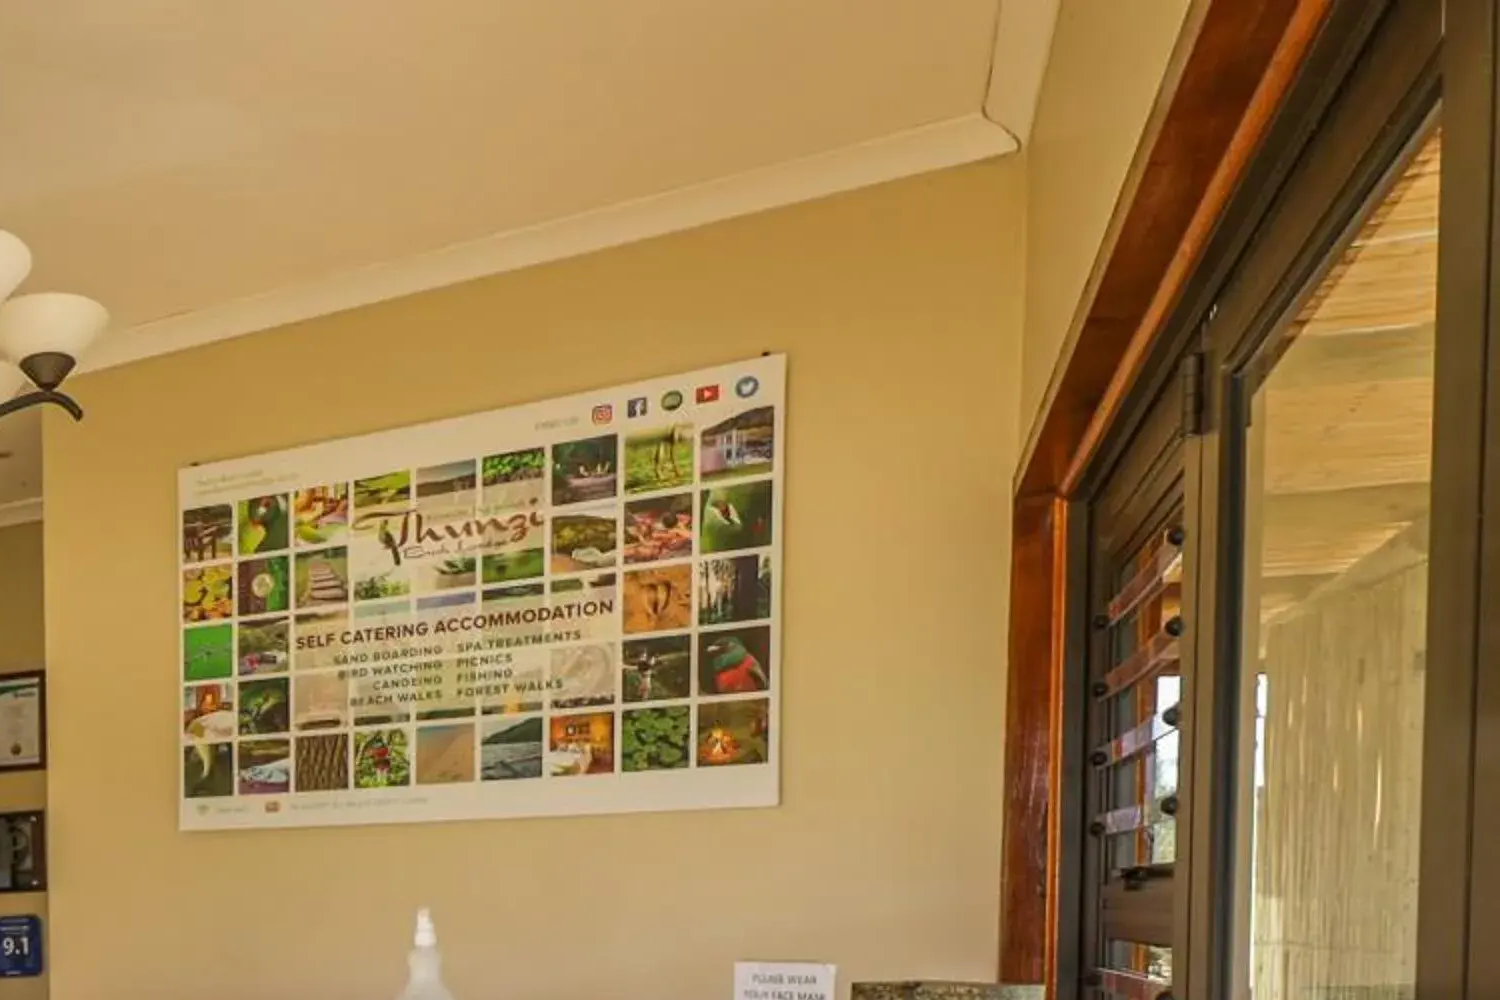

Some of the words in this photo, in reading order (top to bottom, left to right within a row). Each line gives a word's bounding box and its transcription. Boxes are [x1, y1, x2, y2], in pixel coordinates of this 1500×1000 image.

[351, 498, 545, 547] Thunzi
[296, 633, 335, 650] SELF
[340, 622, 429, 645] CATERING
[433, 600, 613, 635] ACCOMMODATION
[334, 653, 369, 666] SAND
[373, 645, 443, 662] BOARDING
[457, 641, 482, 653] SPA
[487, 630, 582, 650] TREATMENTS
[337, 667, 369, 681] BIRD
[372, 660, 443, 677] WATCHING
[457, 653, 513, 669] PICNICS
[372, 675, 443, 691] CANOEING
[457, 668, 513, 684] FISHING
[350, 694, 393, 707] BEACH
[397, 689, 443, 702] WALKS
[457, 683, 510, 698] FOREST
[514, 678, 563, 694] WALKS
[3, 937, 29, 957] 9.1
